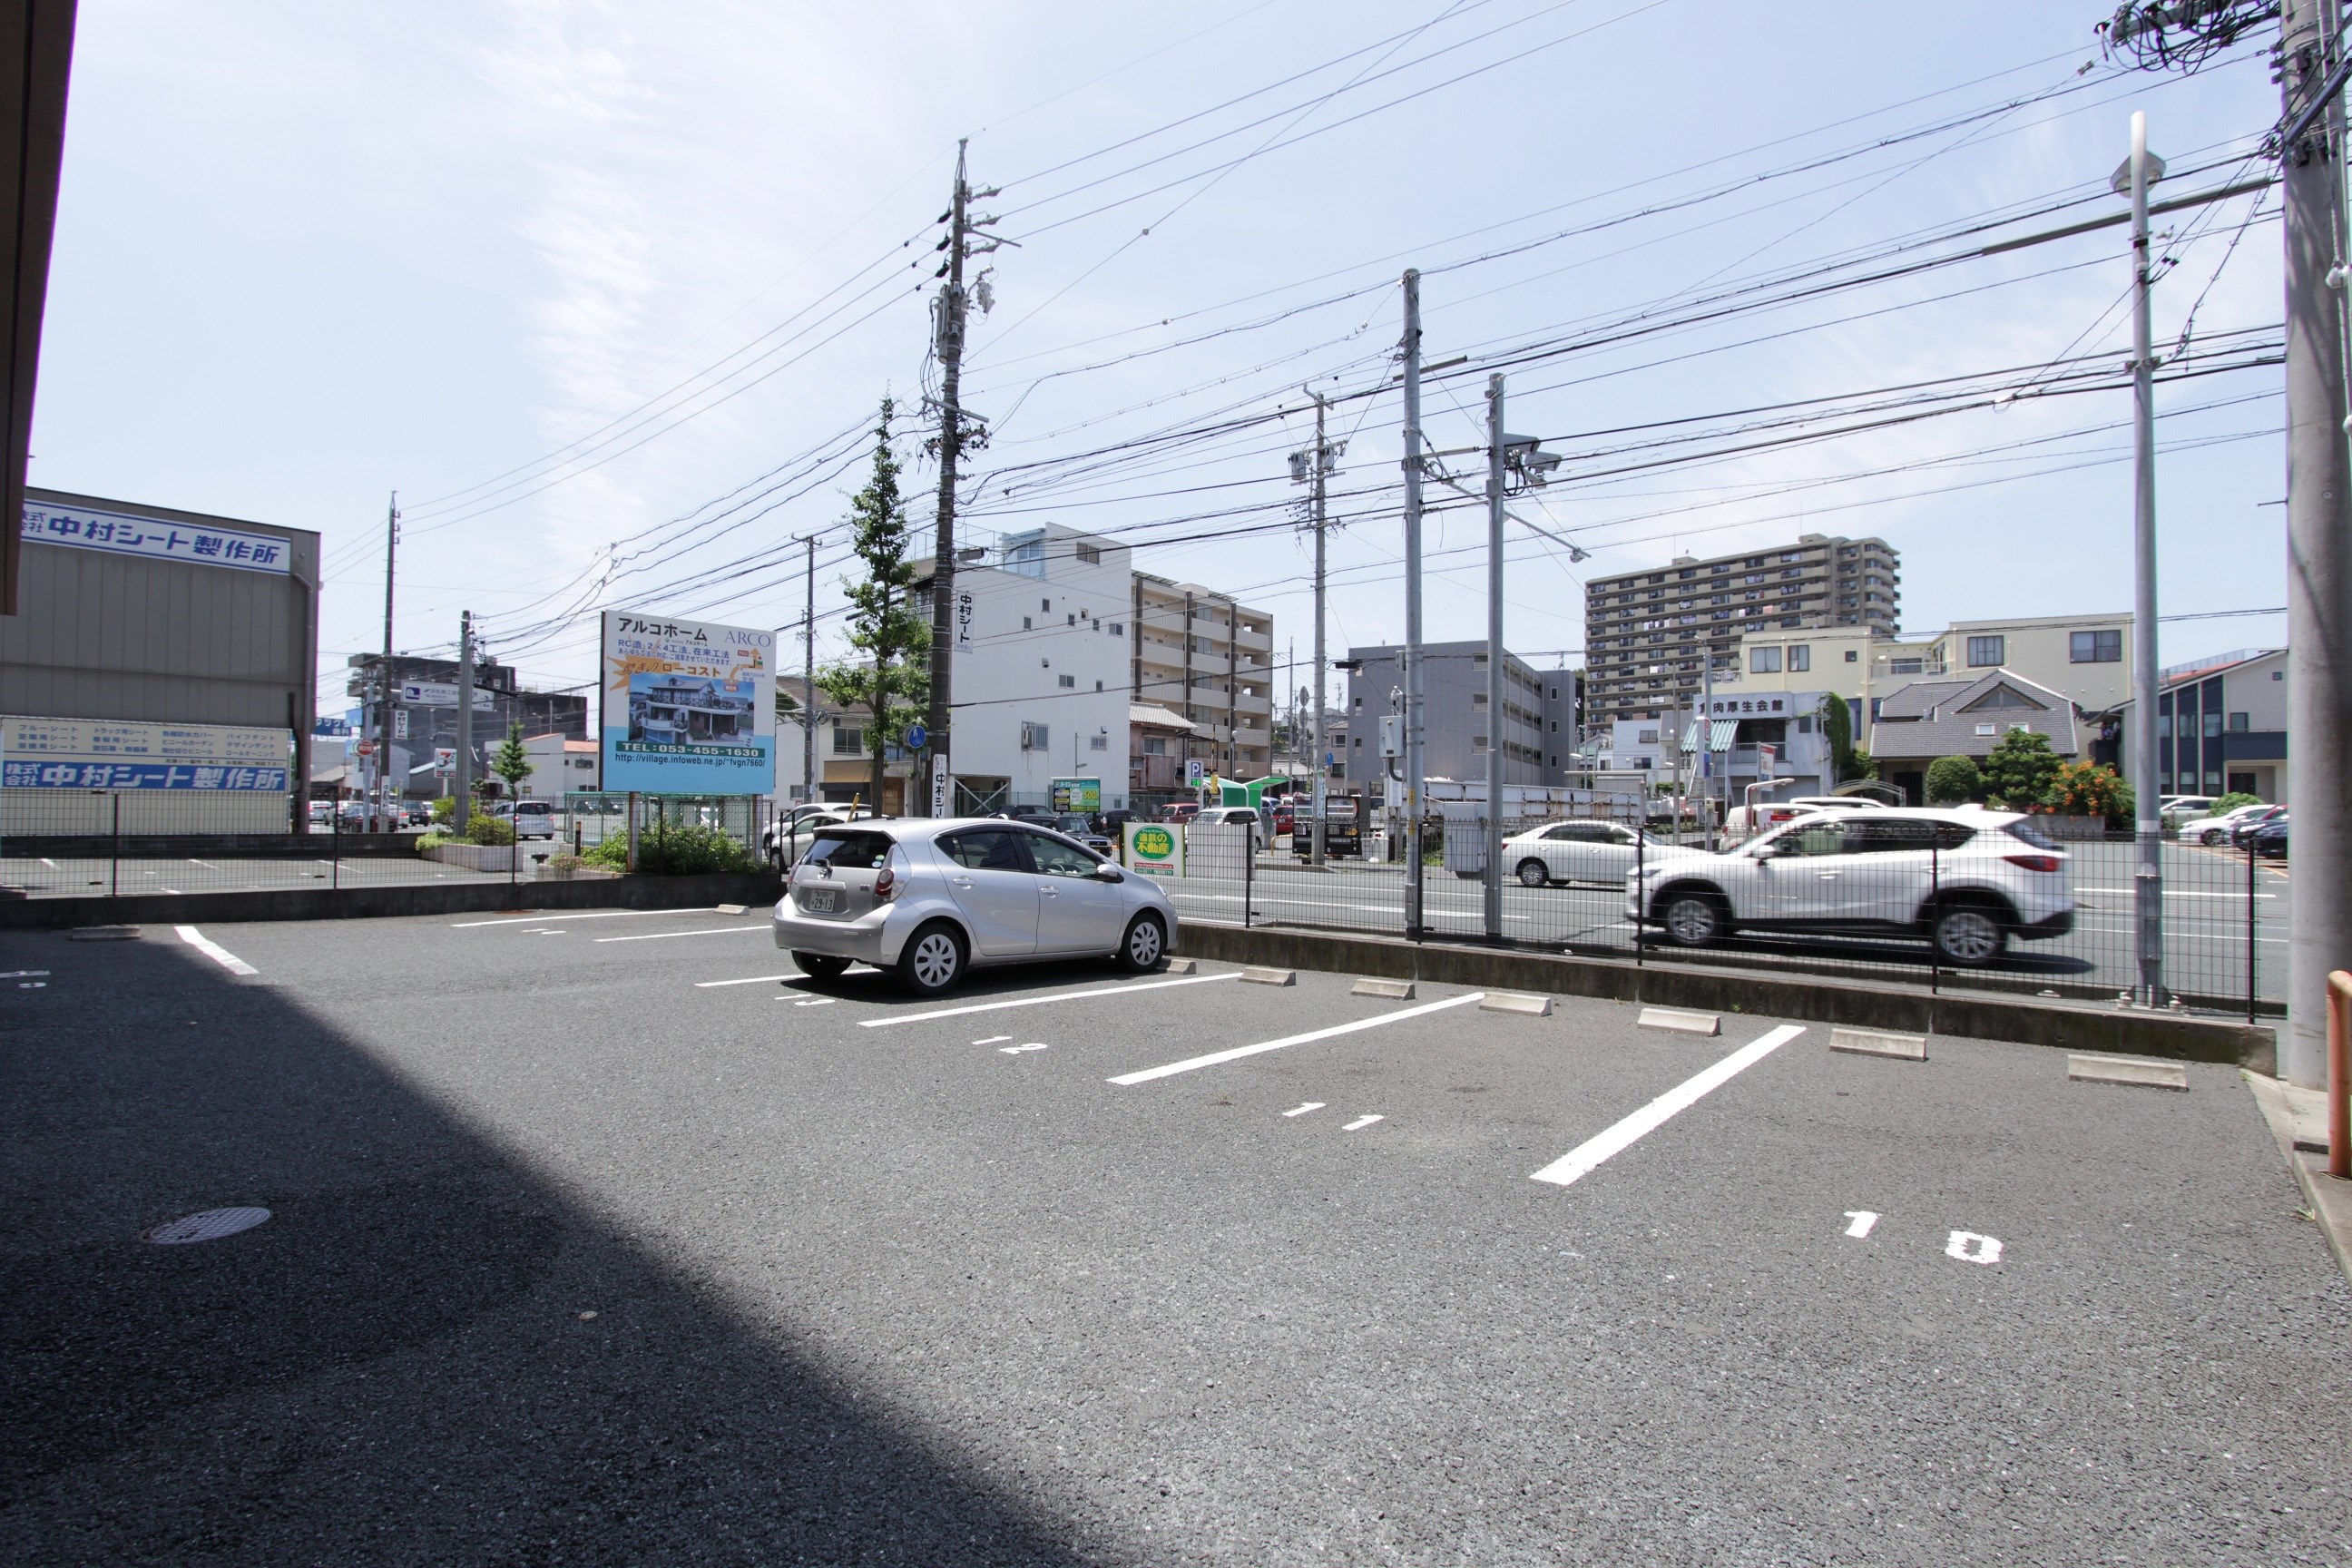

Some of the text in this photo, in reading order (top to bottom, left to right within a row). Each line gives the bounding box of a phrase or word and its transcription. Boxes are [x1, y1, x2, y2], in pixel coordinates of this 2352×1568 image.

[48, 515, 280, 564] 中村シート製作所
[959, 594, 972, 643] 中村シート
[619, 617, 708, 642] アルコホーム
[724, 630, 771, 648] ARCO
[662, 662, 720, 677] ローコスト
[5, 763, 41, 775] 株式
[42, 764, 284, 789] 中村シート製作所
[5, 775, 38, 787] 会社
[1139, 832, 1168, 843] 遠鉄の
[1136, 841, 1170, 855] 不動産
